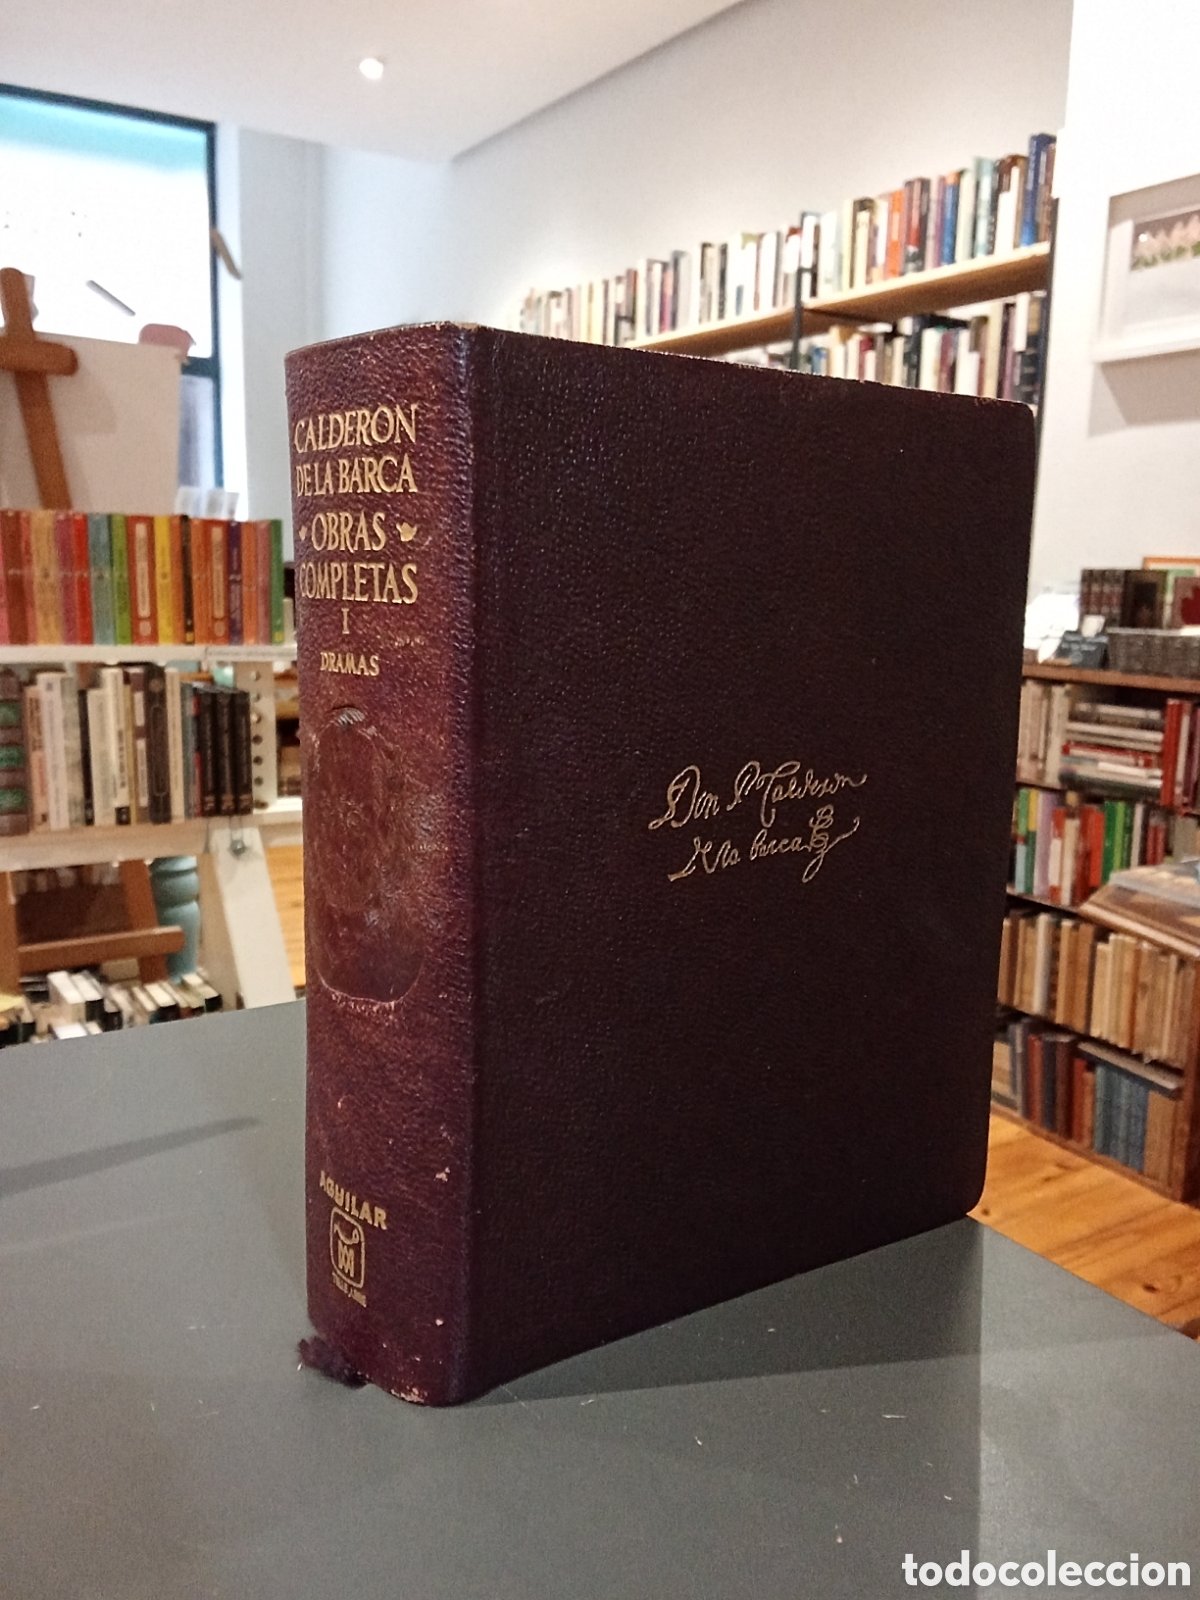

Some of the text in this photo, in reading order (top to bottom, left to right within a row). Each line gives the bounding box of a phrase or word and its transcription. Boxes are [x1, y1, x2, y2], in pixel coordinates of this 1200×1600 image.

[294, 403, 418, 454] CALDERON
[296, 453, 418, 497] DE LA BARCA
[311, 509, 387, 553] OBRAS
[299, 561, 419, 604] COMPLETAS
[341, 608, 350, 635] I
[320, 651, 380, 676] DRAMAS
[319, 1170, 388, 1230] AGUILAR
